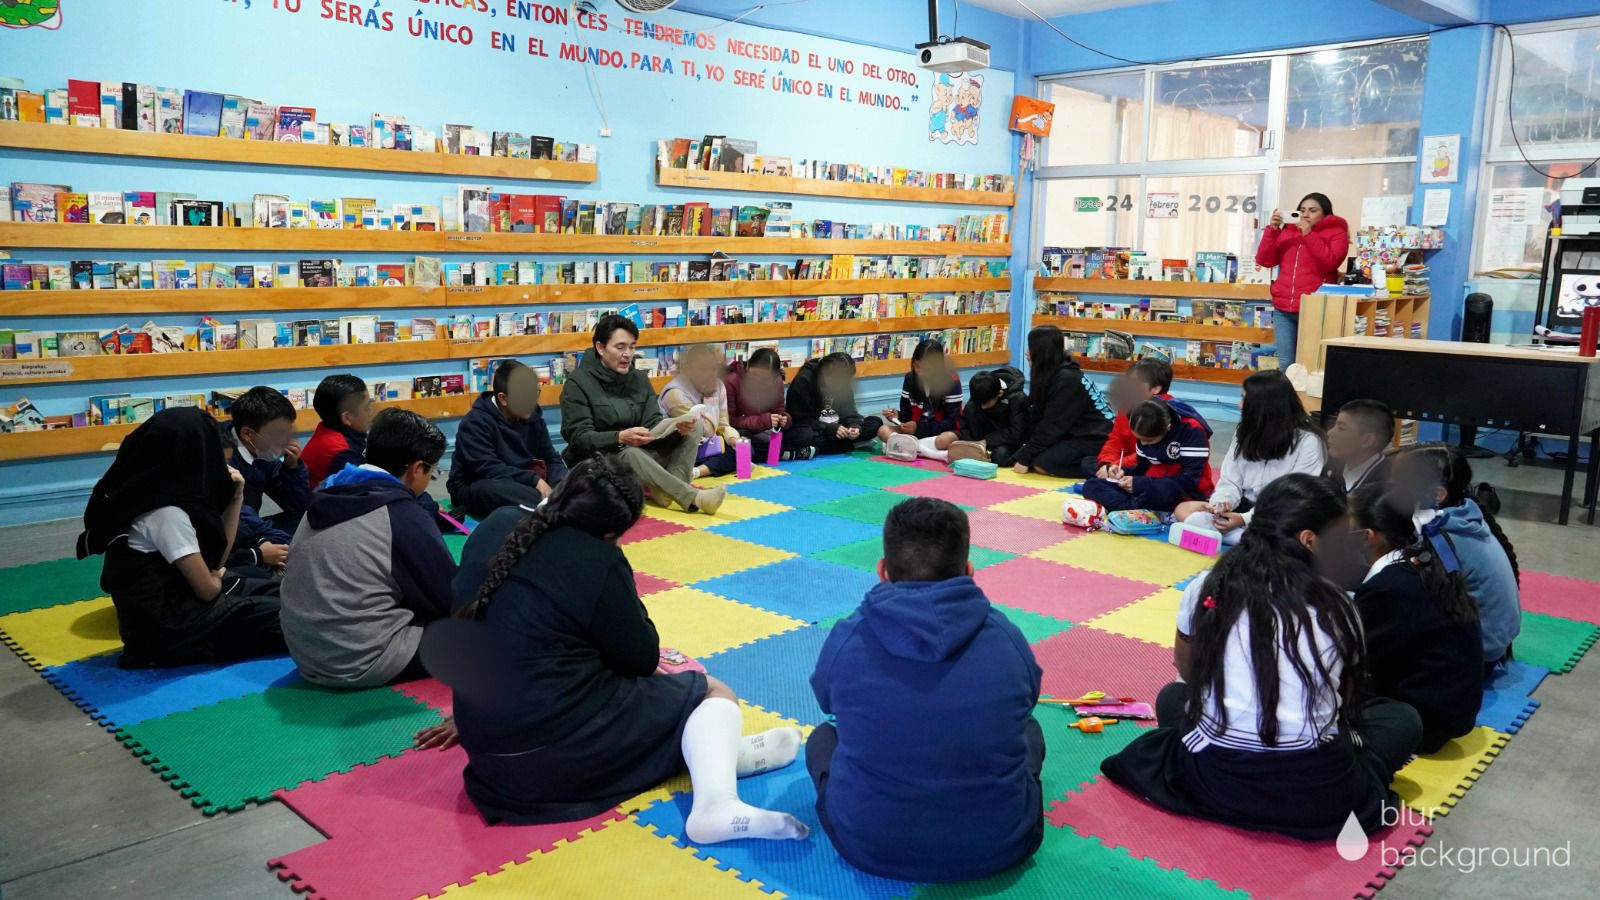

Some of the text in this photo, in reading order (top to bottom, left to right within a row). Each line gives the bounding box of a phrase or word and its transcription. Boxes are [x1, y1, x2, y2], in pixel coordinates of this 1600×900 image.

[321, 0, 394, 32] SERÁS
[408, 9, 473, 46] ÚNICO
[491, 31, 516, 53] EN
[529, 37, 549, 58] EL
[631, 52, 674, 75] PARA
[682, 60, 701, 82] TI,
[706, 64, 725, 82] YO
[734, 68, 766, 90] SERÉ
[772, 69, 812, 96] ÚNICO
[818, 84, 833, 100] EN
[840, 87, 853, 103] EL
[623, 18, 715, 50] TENDREMOS
[728, 38, 800, 63] NECESIDAD
[808, 53, 822, 70] EL
[828, 57, 854, 75] UNO
[862, 63, 882, 80] DEL
[887, 68, 920, 90] OTRO.
[1106, 194, 1133, 212] 24
[1188, 194, 1258, 214] 2026
